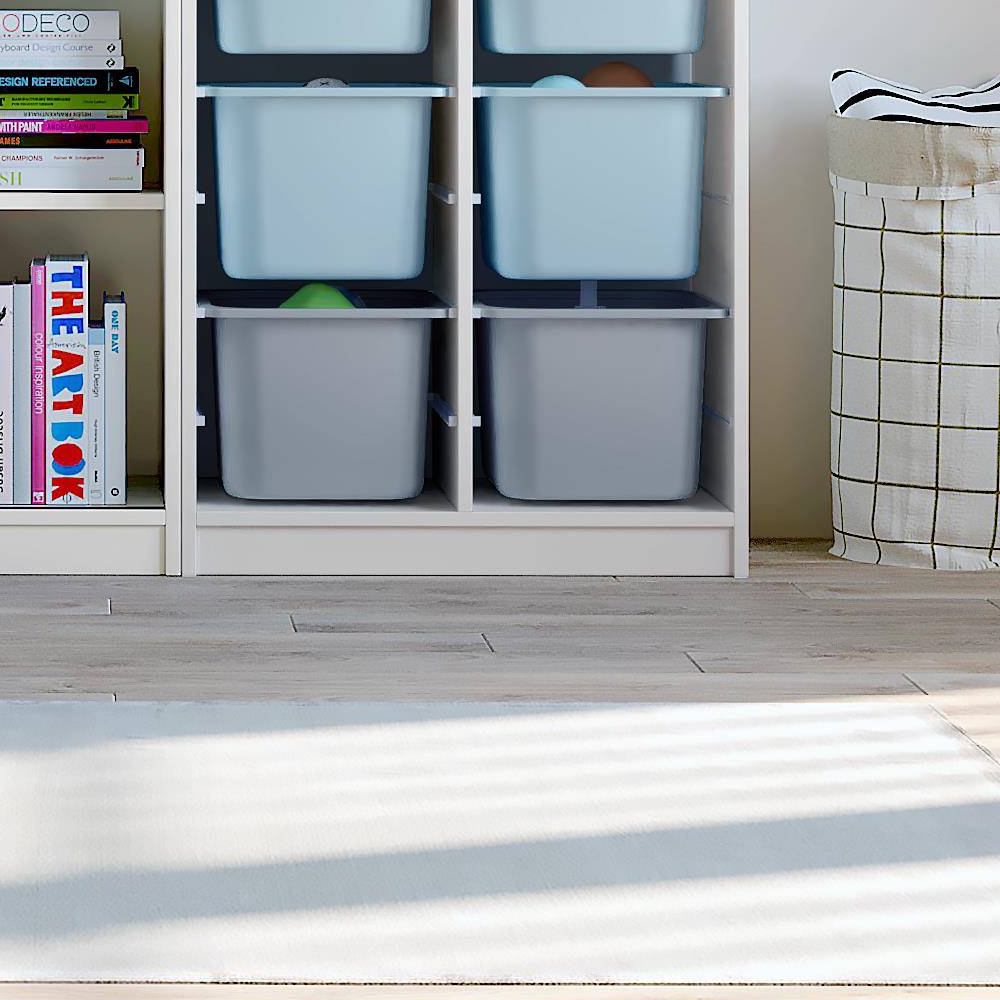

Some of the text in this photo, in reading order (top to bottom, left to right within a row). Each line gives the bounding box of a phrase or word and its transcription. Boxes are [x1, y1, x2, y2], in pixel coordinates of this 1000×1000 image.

[32, 77, 97, 87] REFERENCED
[18, 122, 44, 132] PAINT
[52, 266, 84, 335] THE
[34, 333, 43, 363] colour
[111, 310, 119, 354] ONE DAY
[52, 350, 84, 414] ART
[91, 373, 100, 398] Design
[52, 421, 86, 500] BOOK
